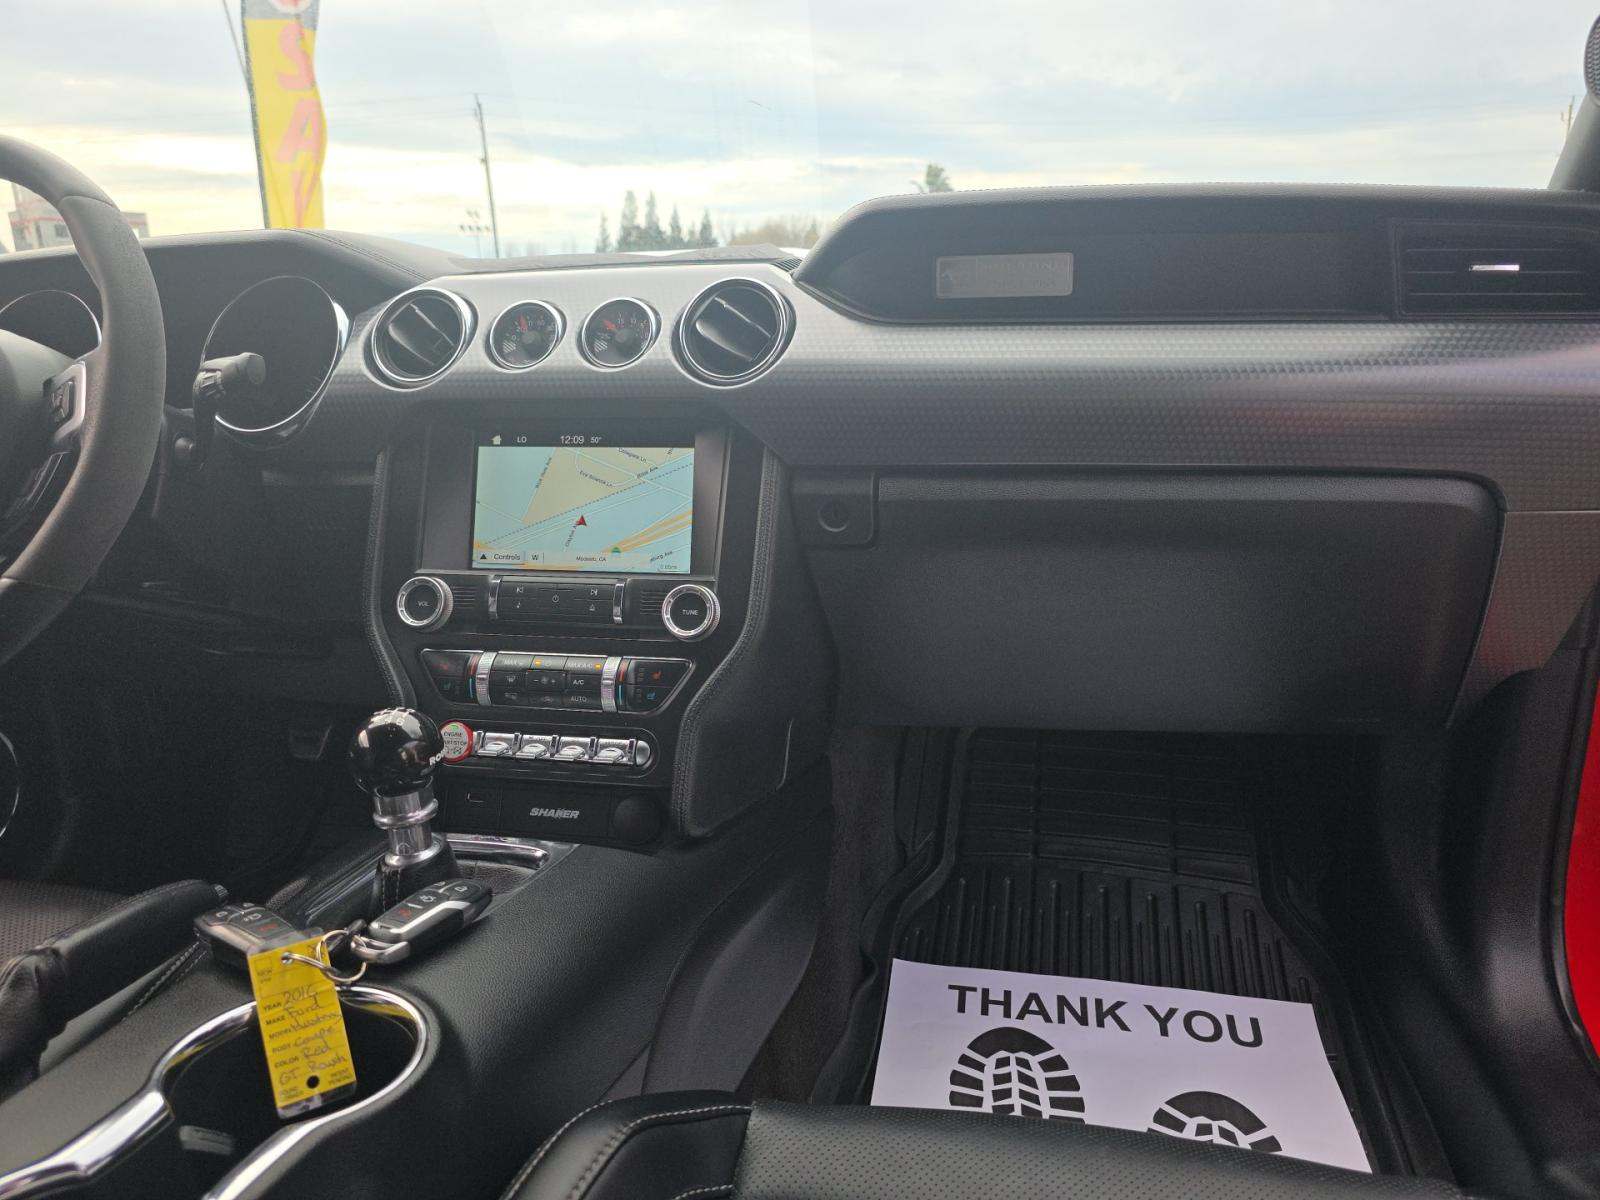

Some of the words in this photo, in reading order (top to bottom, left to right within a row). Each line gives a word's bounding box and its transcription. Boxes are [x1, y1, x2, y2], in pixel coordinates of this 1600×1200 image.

[560, 435, 585, 444] 12:09
[493, 553, 521, 561] Controls
[681, 608, 699, 616] TUNE
[572, 678, 584, 686] A/C
[570, 695, 587, 703] AUTO
[529, 807, 580, 819] SHAKER
[265, 1014, 286, 1025] MAKE
[947, 983, 1133, 1033] THANK
[1144, 1002, 1264, 1049] YOU
